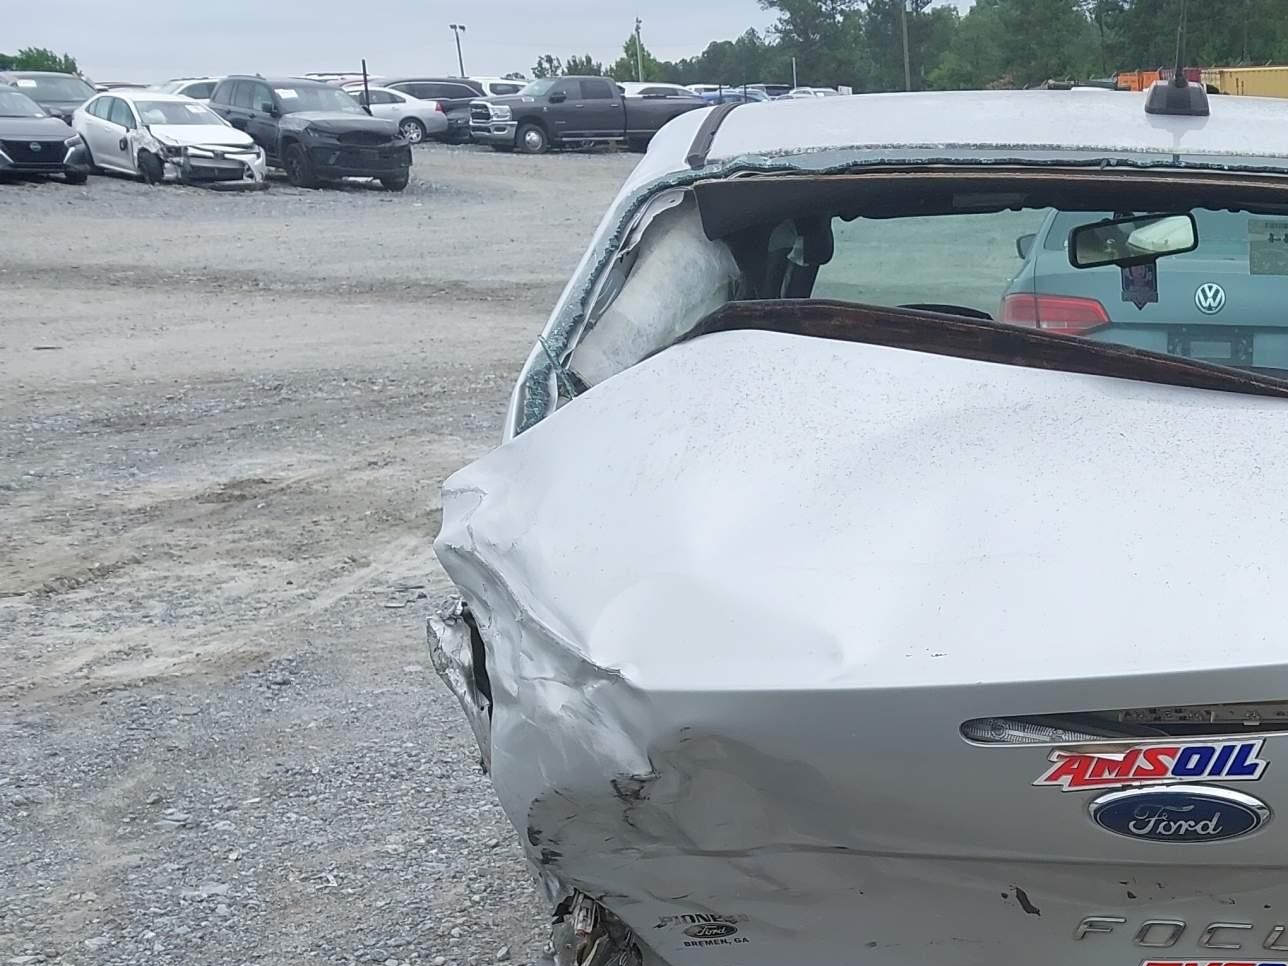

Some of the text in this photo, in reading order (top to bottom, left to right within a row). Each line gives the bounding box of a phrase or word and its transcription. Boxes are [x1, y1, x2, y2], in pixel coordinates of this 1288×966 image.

[1043, 739, 1267, 788] AMSOIL
[1128, 804, 1225, 837] Ford
[683, 938, 732, 947] BREMEN,
